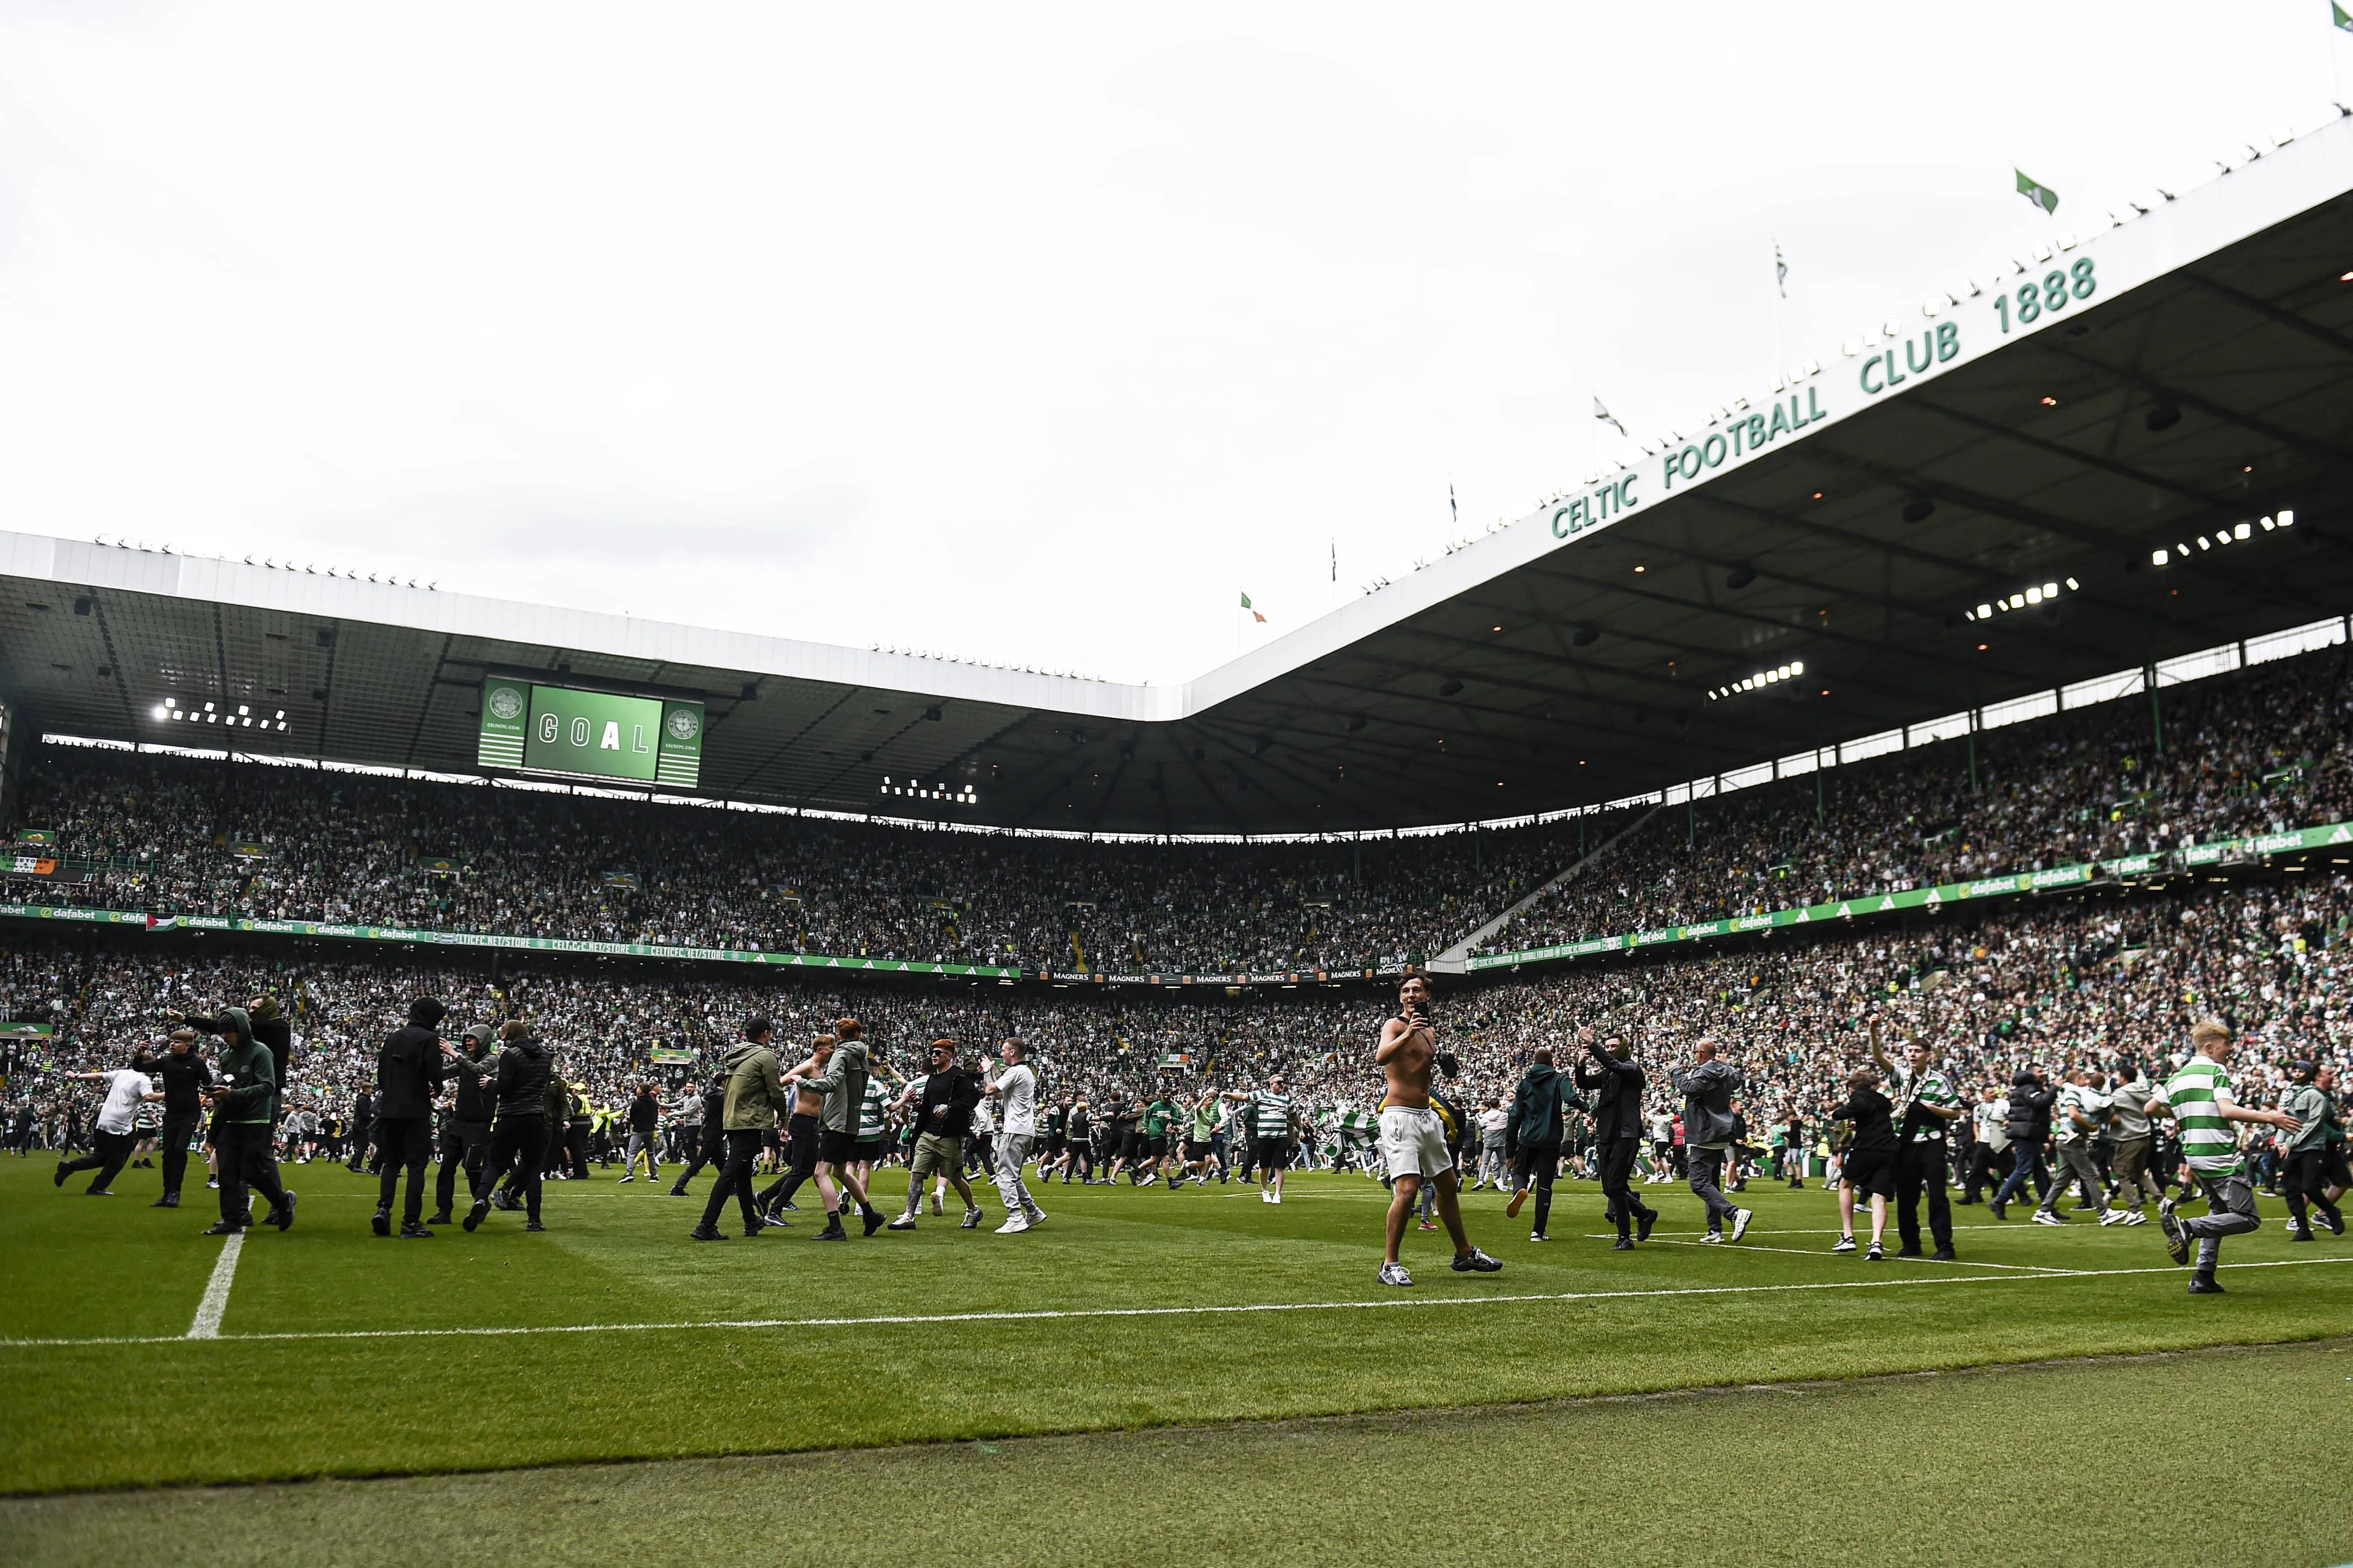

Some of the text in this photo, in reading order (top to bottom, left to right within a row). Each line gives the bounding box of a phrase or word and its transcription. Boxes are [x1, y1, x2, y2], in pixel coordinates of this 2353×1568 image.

[1551, 256, 2097, 539] CELTIC FOOTBALL CLUB 1888
[539, 713, 649, 754] GOAL
[2032, 865, 2080, 886] dafabet
[1971, 877, 2016, 895] dafabet
[54, 908, 95, 920] dafabet
[122, 913, 146, 923] dafa
[188, 916, 229, 929] dafabet
[254, 921, 293, 933] dafabet
[1739, 915, 1773, 929] dafabet
[318, 925, 356, 937] dafabet
[380, 929, 417, 940] dafabet
[1687, 923, 1718, 937] dafabet
[459, 934, 530, 948] LTICFC.NET/STORE
[1638, 931, 1667, 944] dafabet
[1054, 972, 1089, 981] MAGNERS
[1331, 970, 1361, 979] MAGNERS
[1376, 967, 1398, 976] MAGNE
